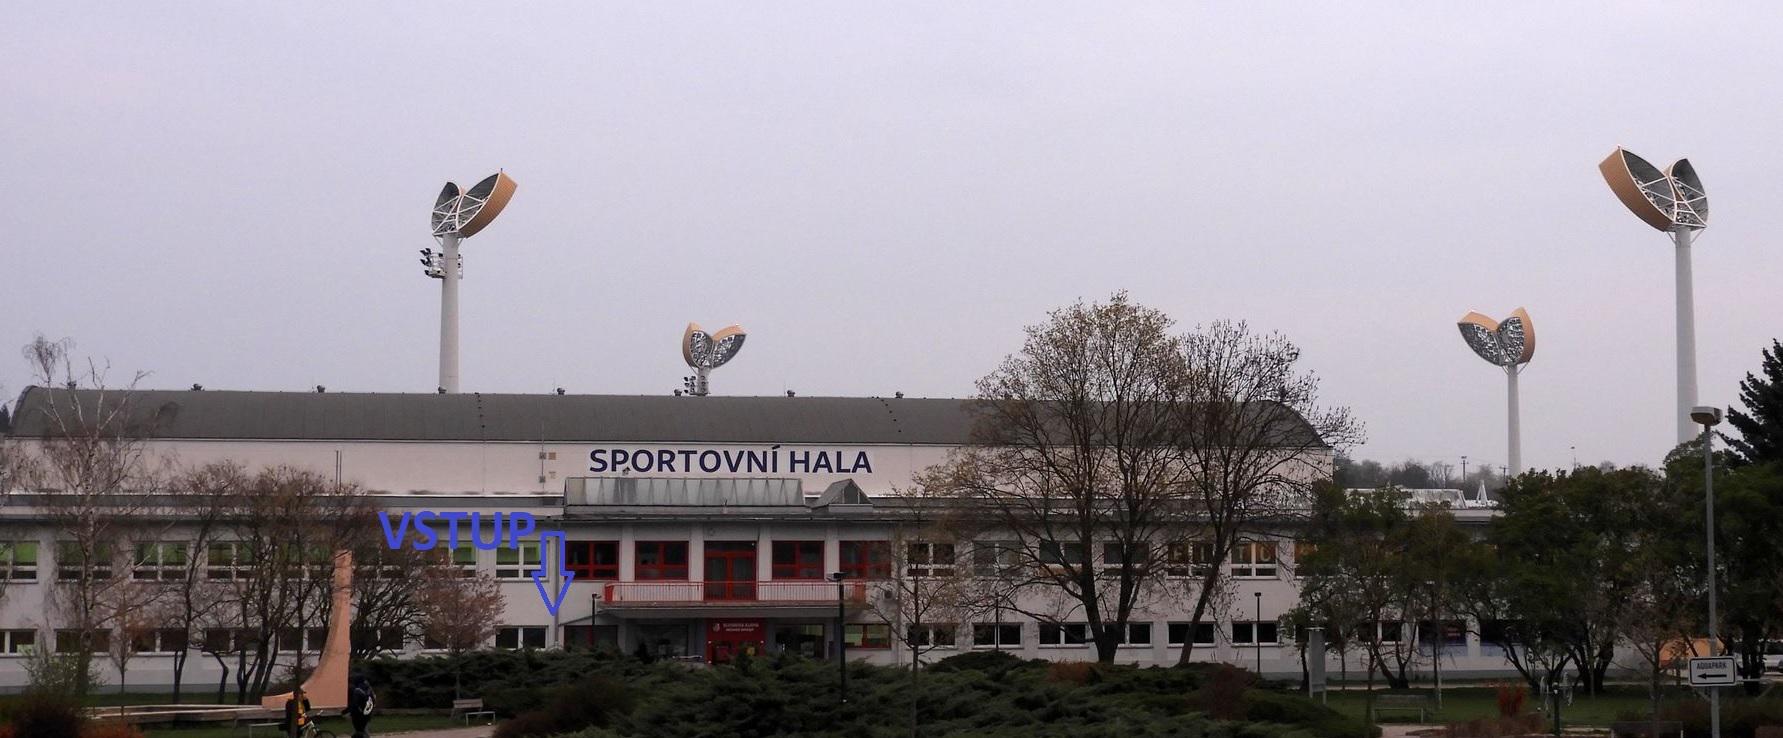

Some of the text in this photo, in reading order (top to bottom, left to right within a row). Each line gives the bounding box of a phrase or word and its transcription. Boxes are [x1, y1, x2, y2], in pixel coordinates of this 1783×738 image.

[589, 444, 873, 474] SPORTOVNÍ HALA
[1696, 661, 1727, 669] AQUAPARK
